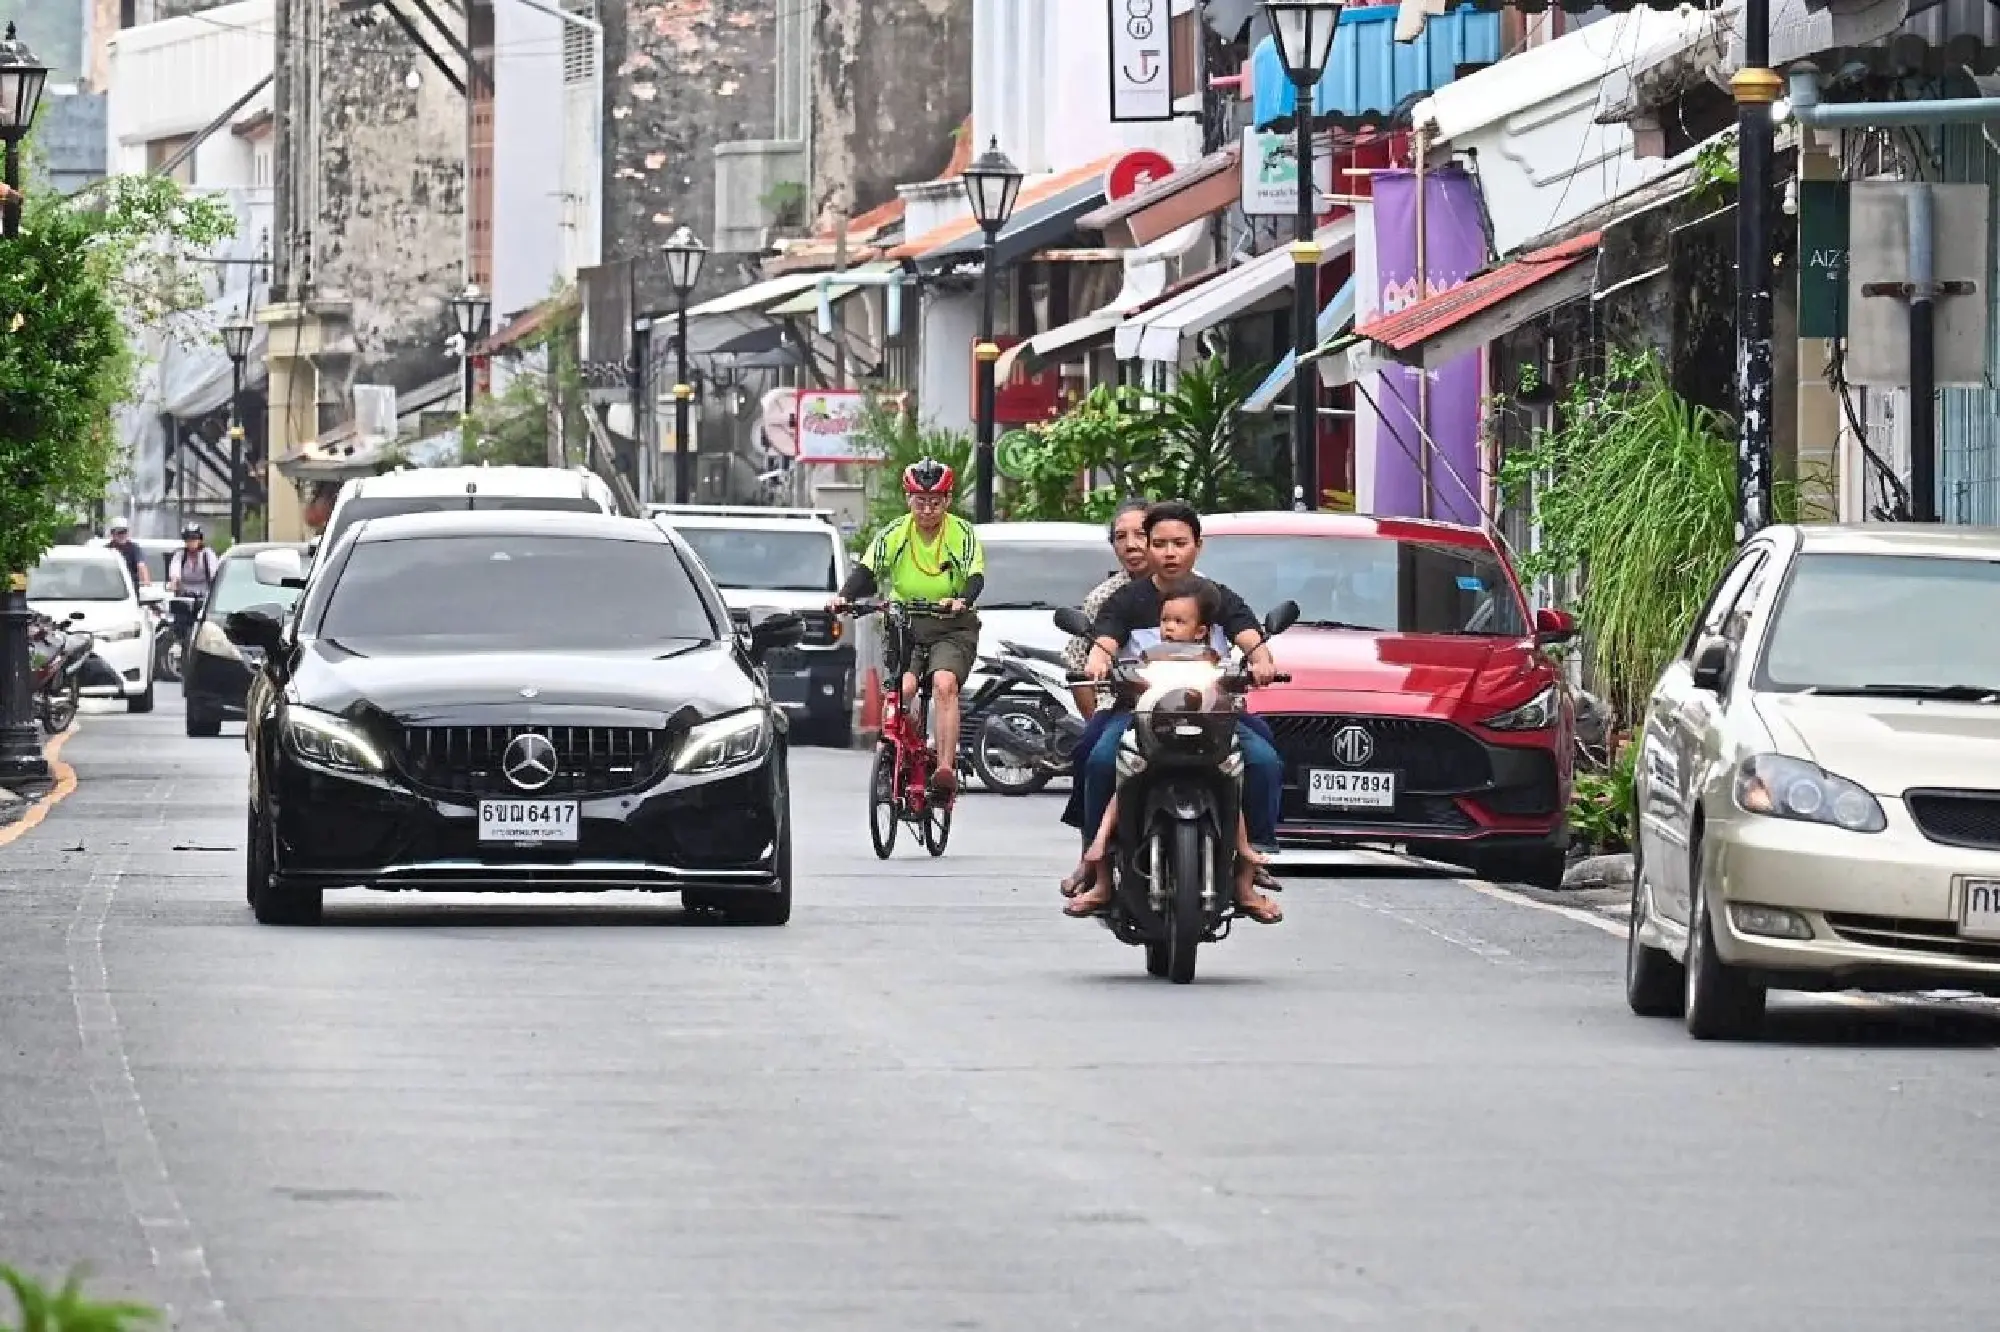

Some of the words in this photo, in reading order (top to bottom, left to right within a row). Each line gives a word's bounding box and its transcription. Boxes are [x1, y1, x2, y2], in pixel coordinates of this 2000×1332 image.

[1335, 729, 1370, 763] MG
[1352, 775, 1390, 793] 7894
[528, 804, 575, 823] 6417
